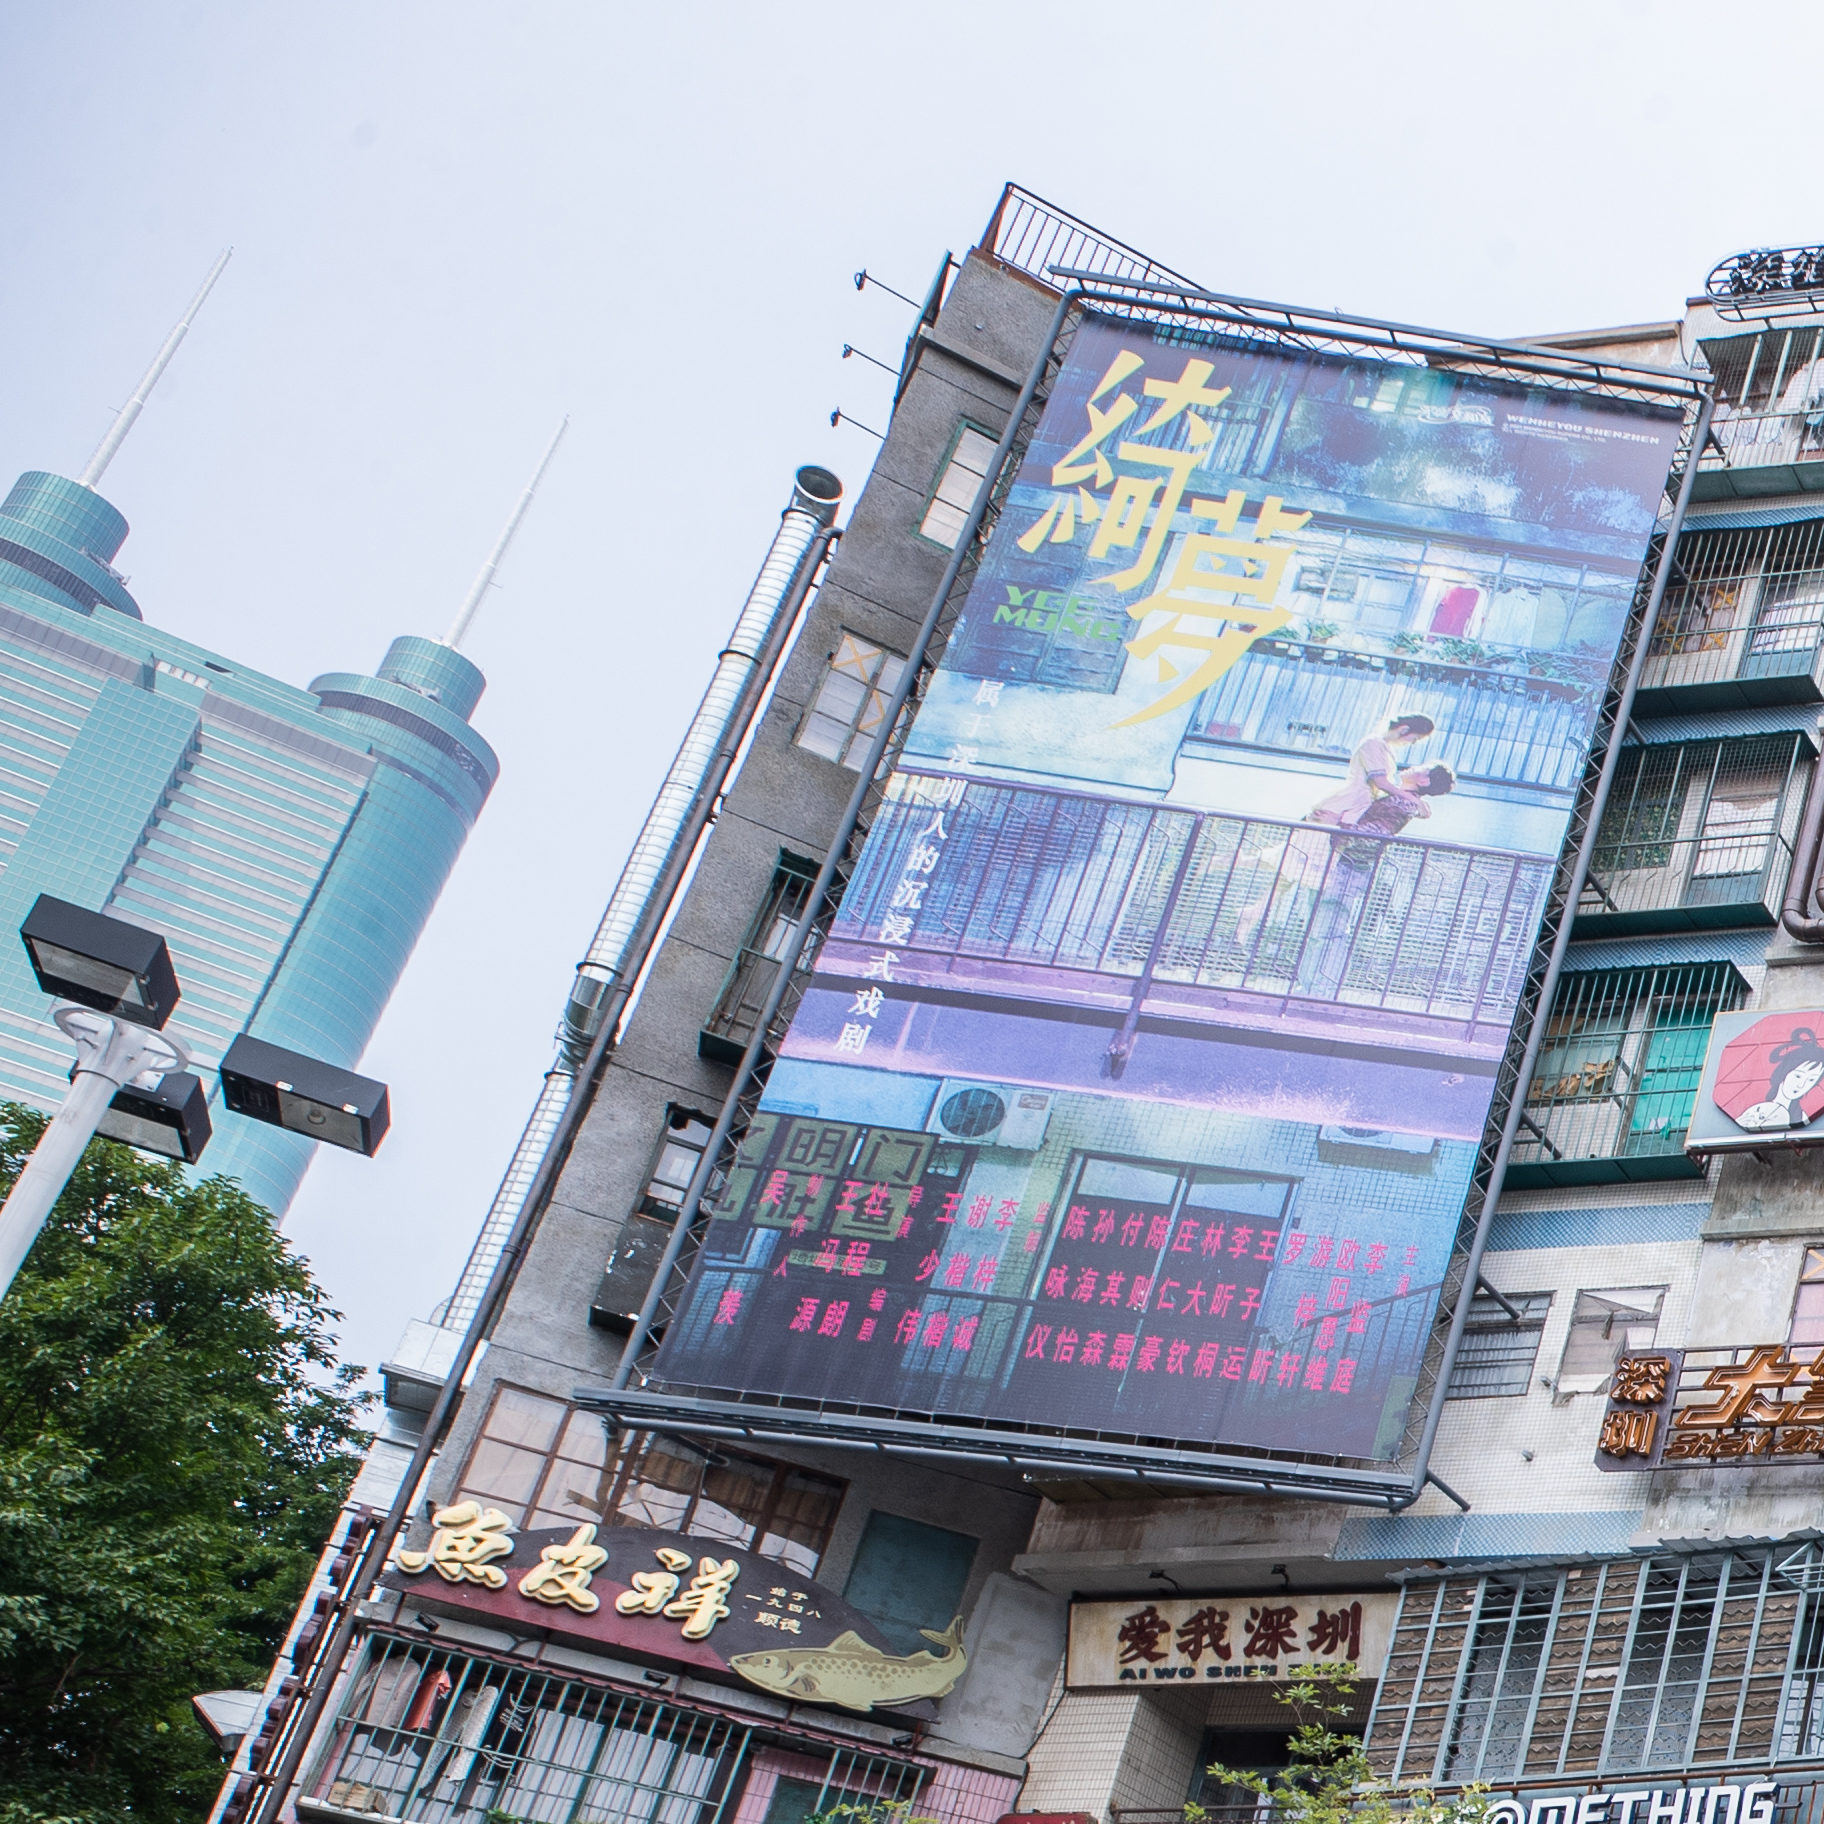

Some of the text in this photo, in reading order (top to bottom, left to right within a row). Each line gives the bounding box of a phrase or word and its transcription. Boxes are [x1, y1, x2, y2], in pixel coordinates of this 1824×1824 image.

[834, 679, 1003, 1056] 属于深圳人的沉浸式戏剧
[395, 1500, 740, 1641] 魚皮祥
[1117, 1600, 1363, 1665] 愛我深圳
[1118, 1668, 1148, 1681] AI
[1153, 1666, 1197, 1679] WO
[1205, 1664, 1278, 1678] SHEN
